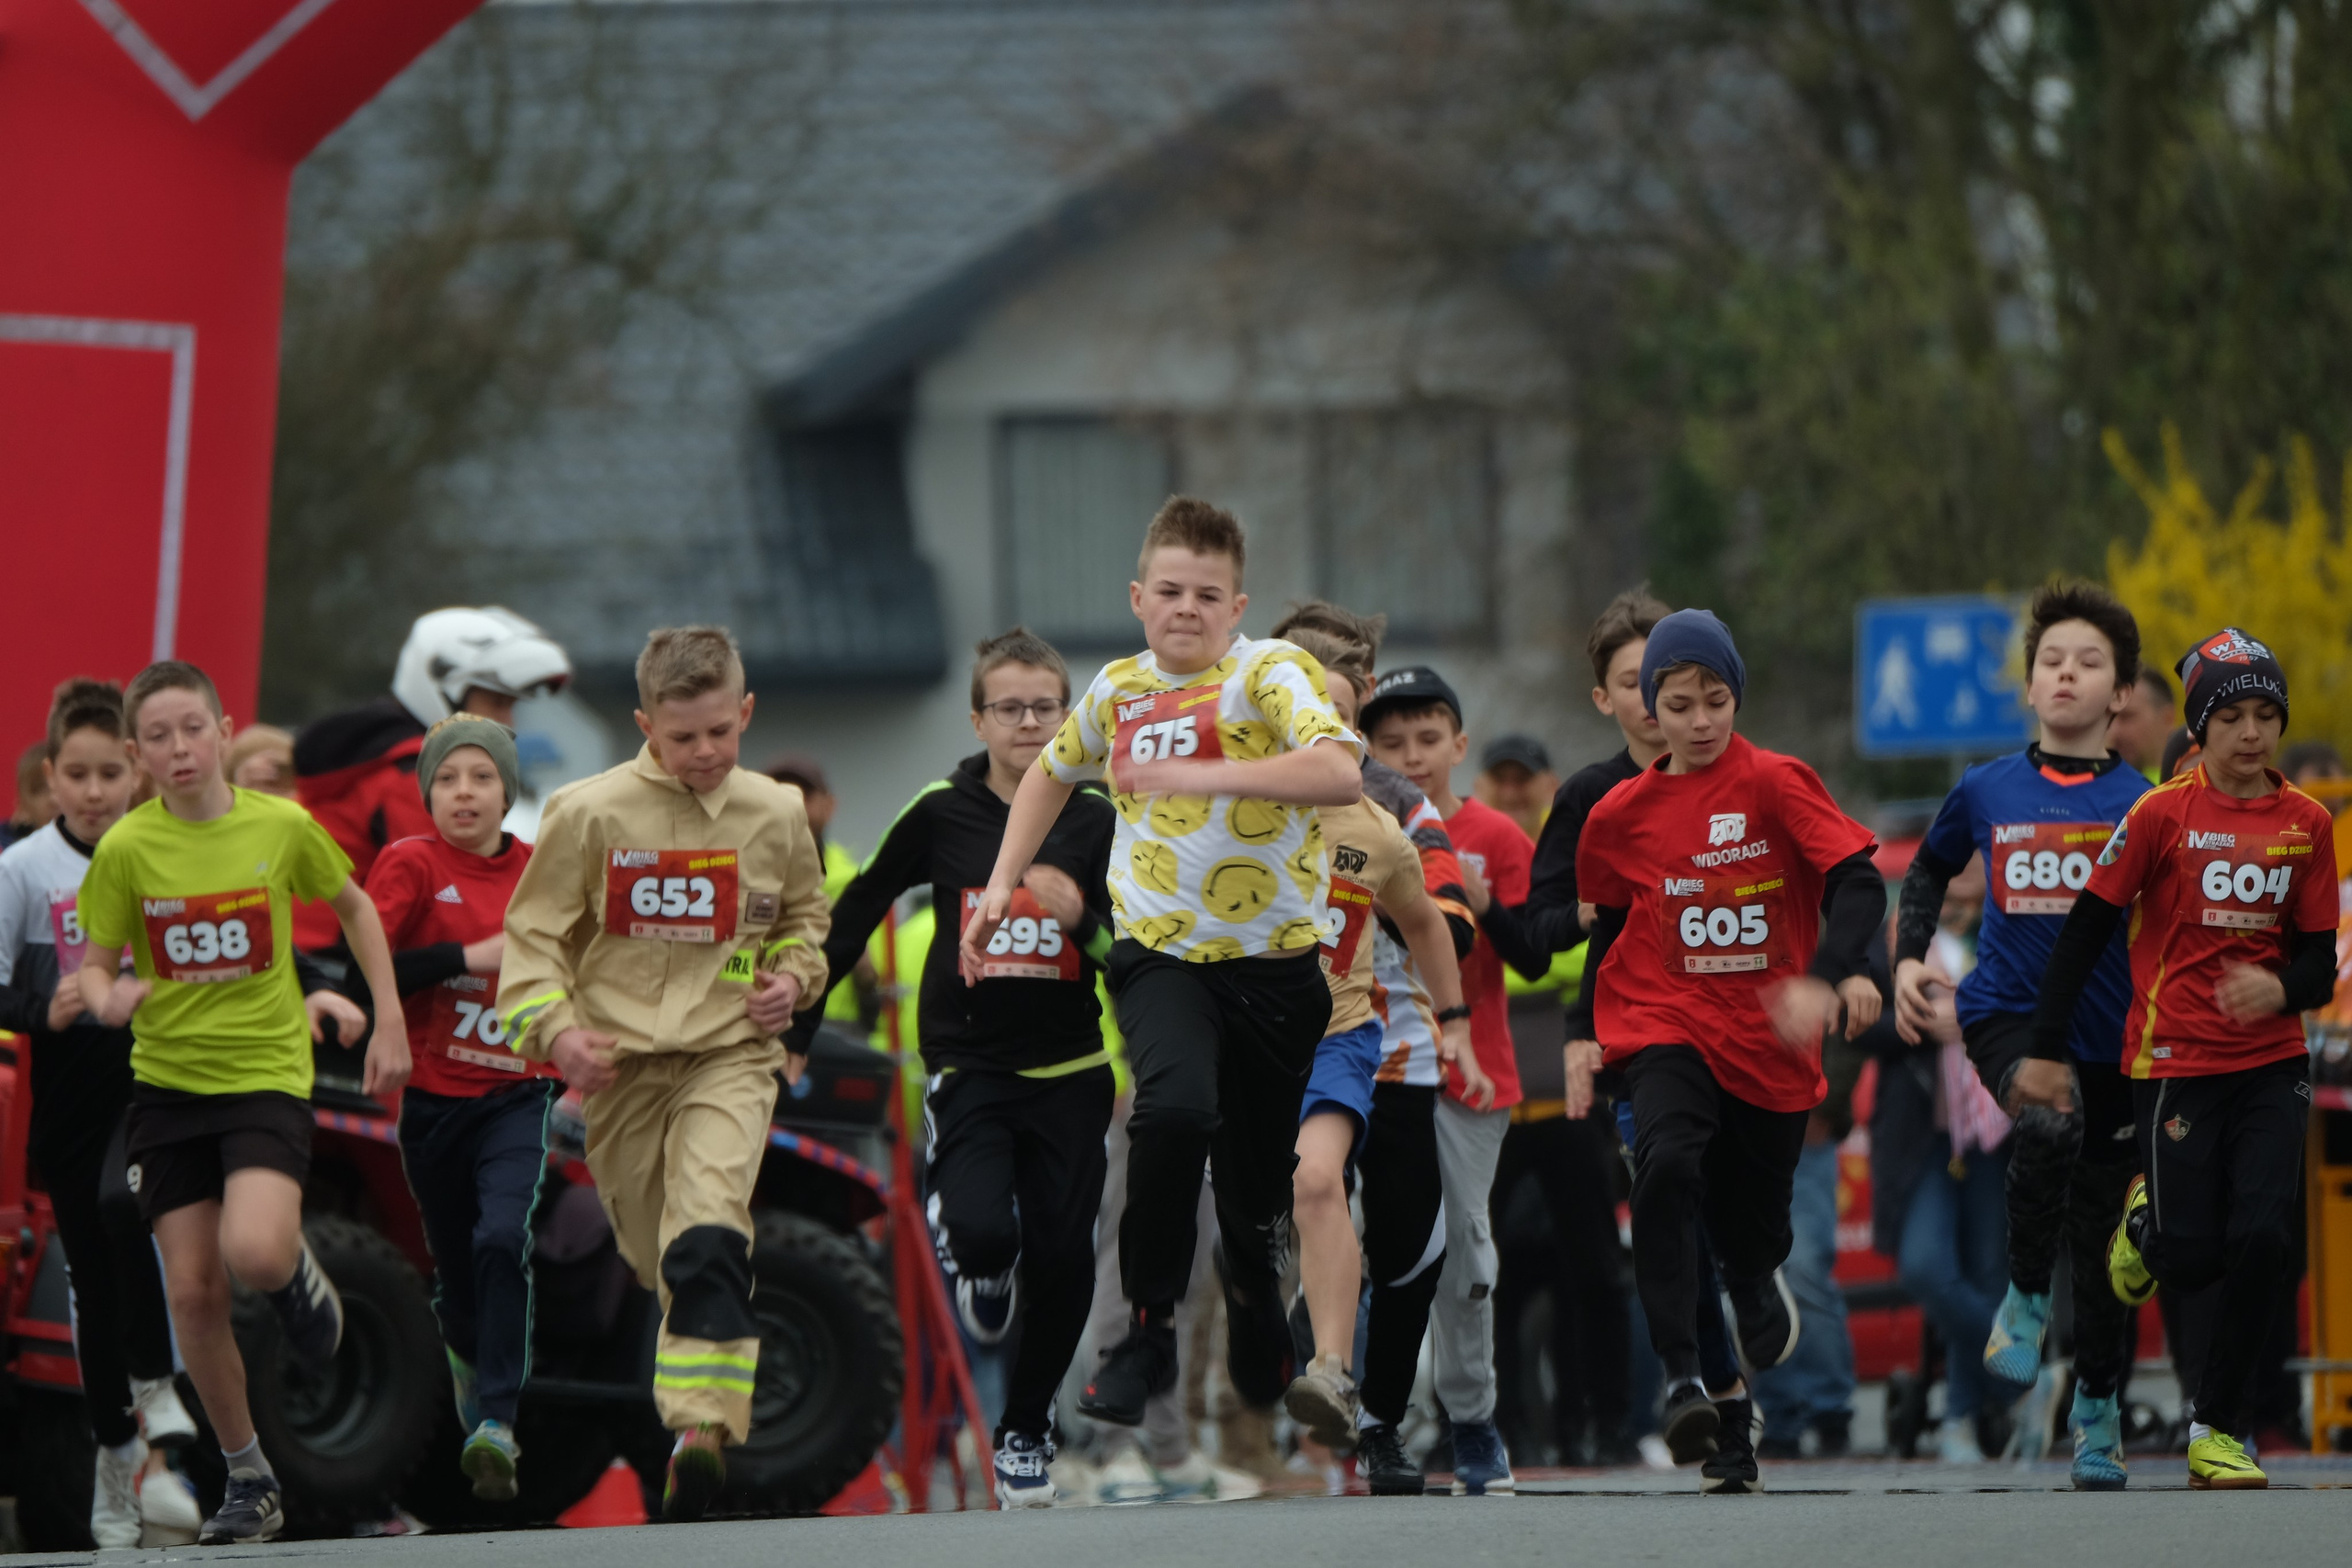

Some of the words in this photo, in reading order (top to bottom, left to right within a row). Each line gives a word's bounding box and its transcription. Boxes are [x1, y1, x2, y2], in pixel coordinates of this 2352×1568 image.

[1134, 698, 1156, 710] BIEG
[1131, 715, 1200, 765] 675
[1691, 839, 1770, 868] WIDORADZ
[2208, 831, 2235, 842] BIEG
[2267, 846, 2288, 855] BIEG
[2289, 845, 2312, 855] DZIECI
[1680, 879, 1704, 887] BIEG
[1735, 885, 1757, 897] BIEG
[2005, 850, 2093, 891] 680
[2201, 859, 2292, 905] 604
[630, 876, 715, 918] 652
[164, 919, 251, 964] 638
[986, 916, 1063, 957] 695
[1679, 904, 1770, 948] 605
[453, 999, 513, 1047] 70
